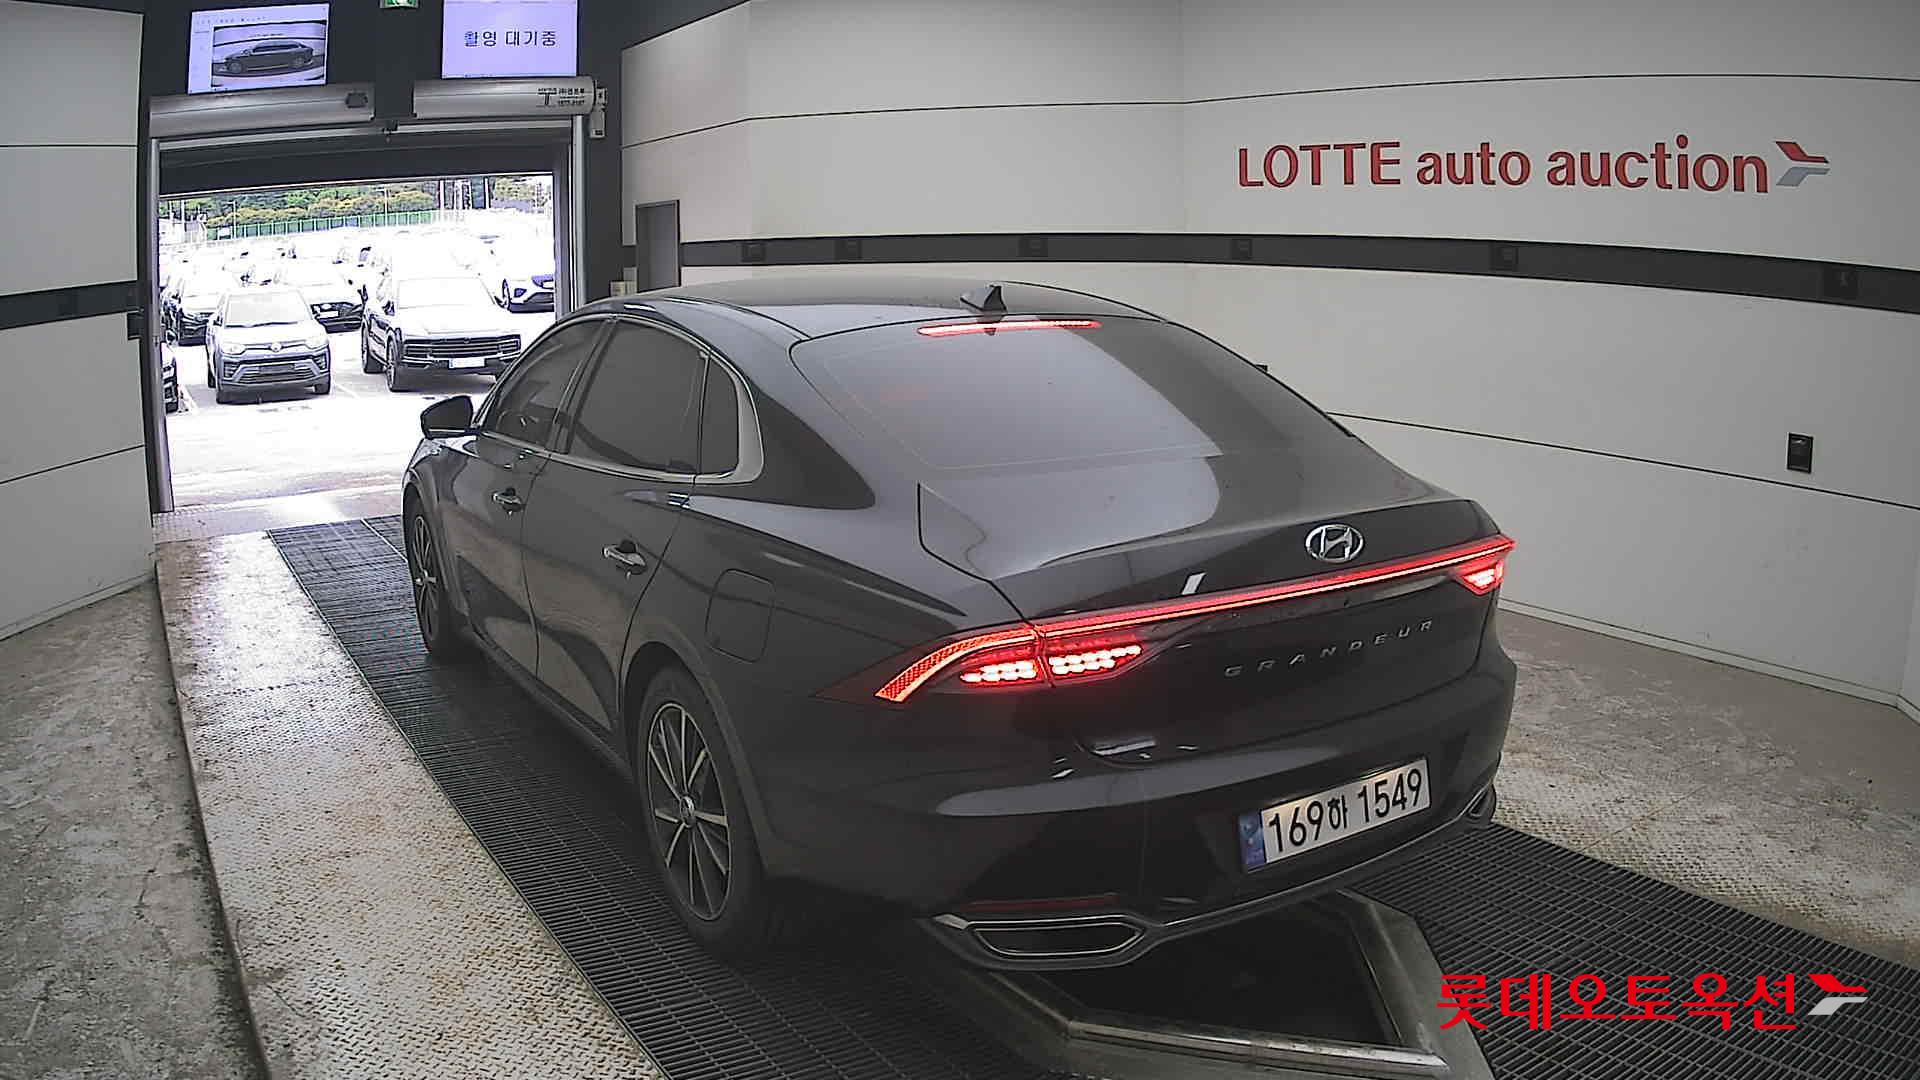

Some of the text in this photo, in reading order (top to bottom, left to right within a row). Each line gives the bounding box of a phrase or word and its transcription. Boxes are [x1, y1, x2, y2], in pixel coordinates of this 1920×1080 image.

[505, 30, 556, 47] 대기중
[1238, 134, 1769, 193] LOTTE auto auction
[1224, 619, 1433, 677] GRANDEUR
[1269, 768, 1422, 853] 169하 1549
